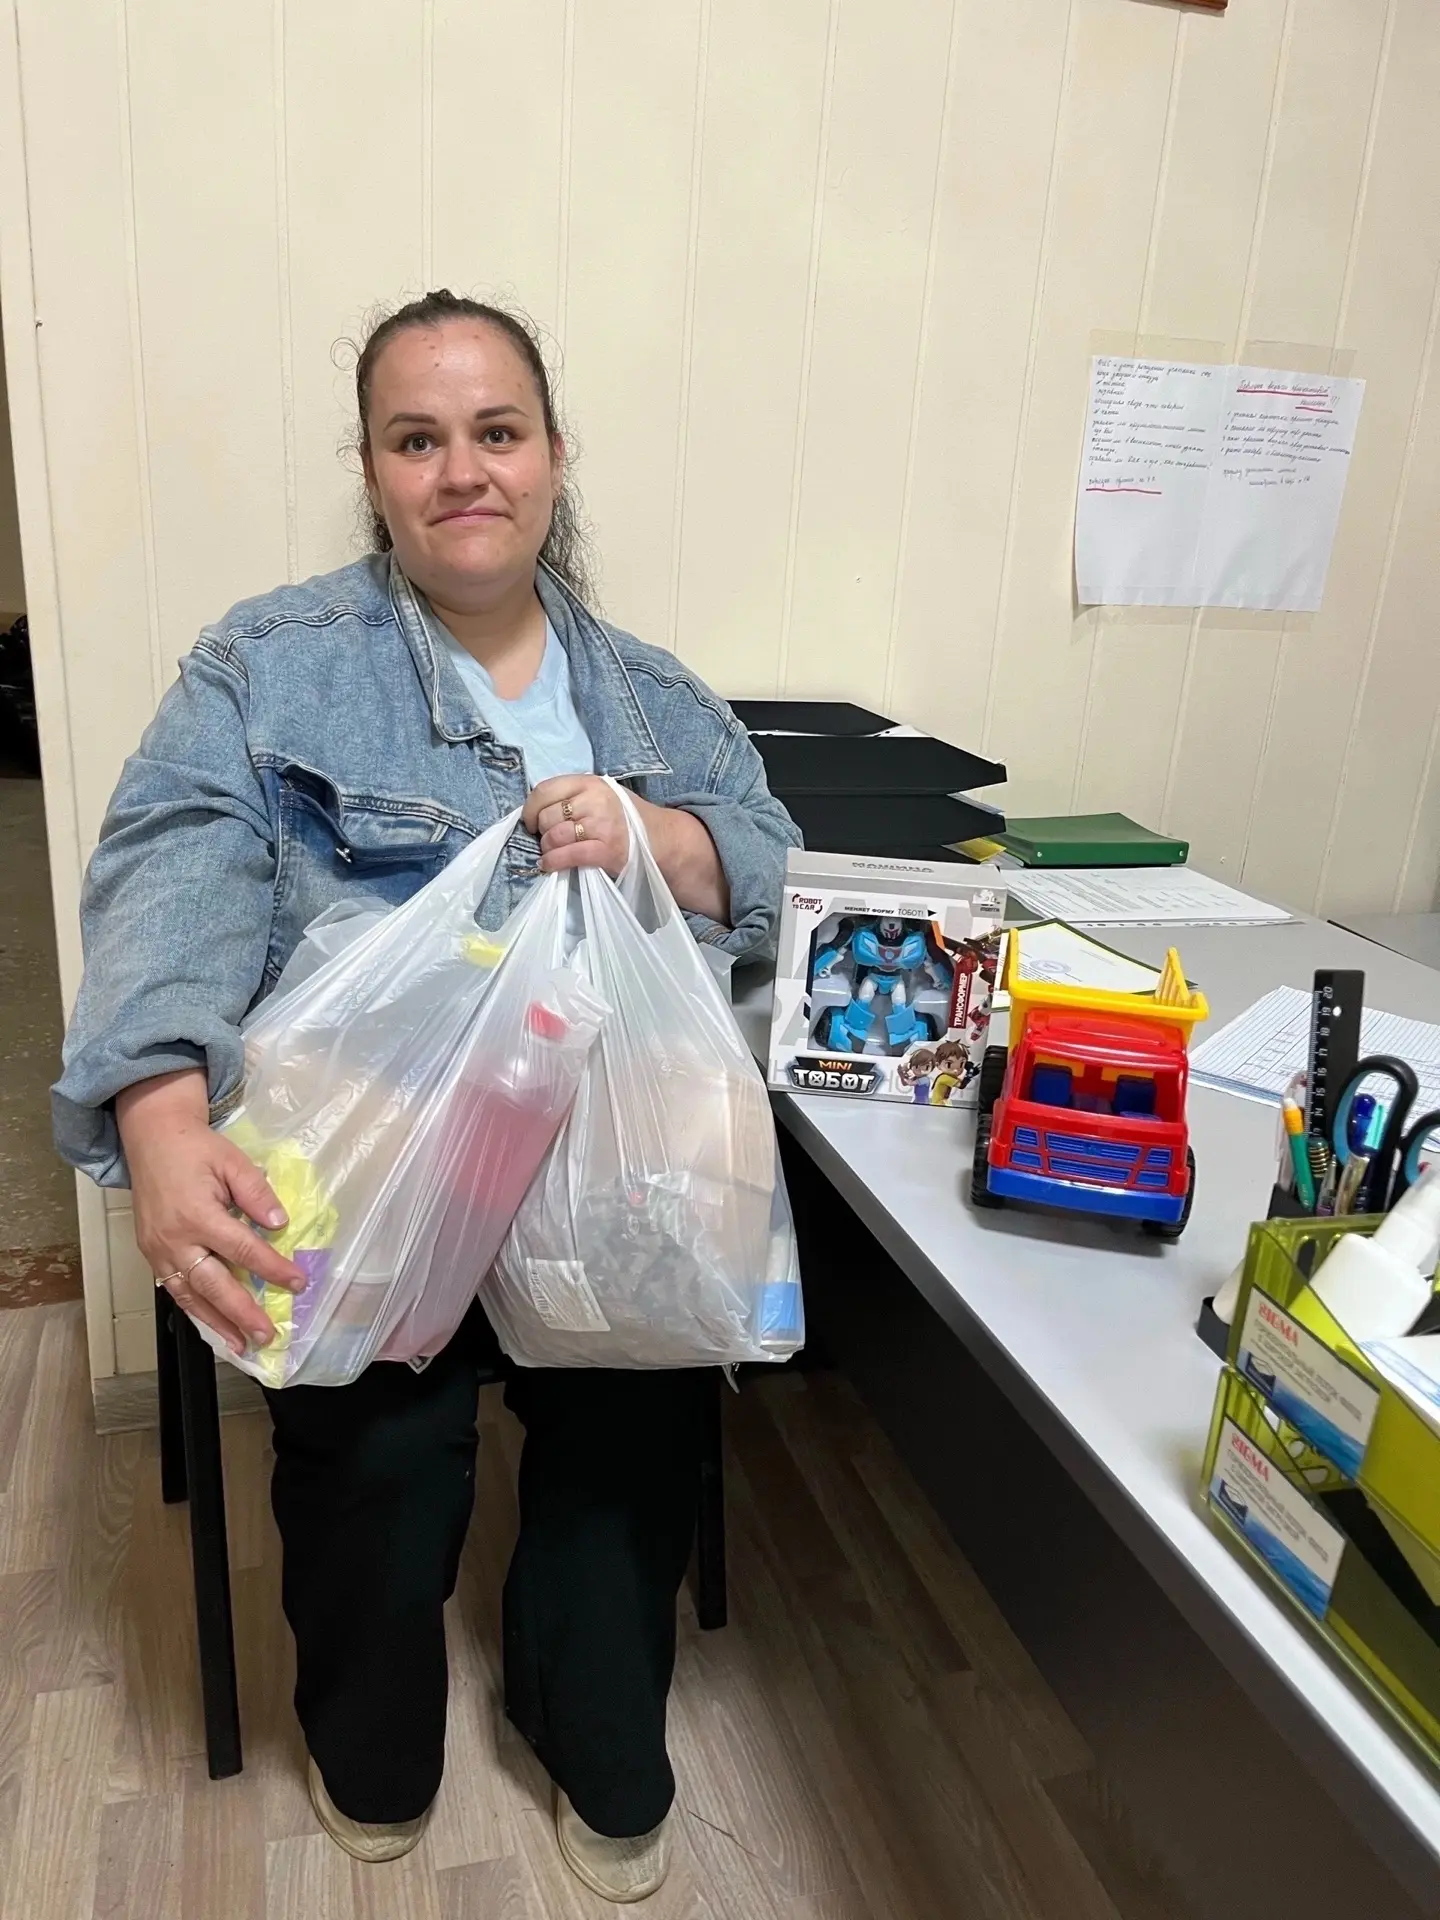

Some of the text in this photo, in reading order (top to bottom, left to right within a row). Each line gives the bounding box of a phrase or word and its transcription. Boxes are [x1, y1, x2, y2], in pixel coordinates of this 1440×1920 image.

[799, 897, 822, 905] ROBOT
[844, 905, 870, 913] МЕНЯЕТ
[898, 908, 924, 917] ТОБОТ!
[1323, 986, 1333, 999] 20
[954, 973, 967, 1026] ТРАНСФОРМЕР
[1322, 1006, 1332, 1016] 19
[818, 1060, 853, 1070] MINI
[1317, 1067, 1328, 1077] 16
[793, 1069, 875, 1091] ТОБОТ
[1316, 1087, 1326, 1096] 15
